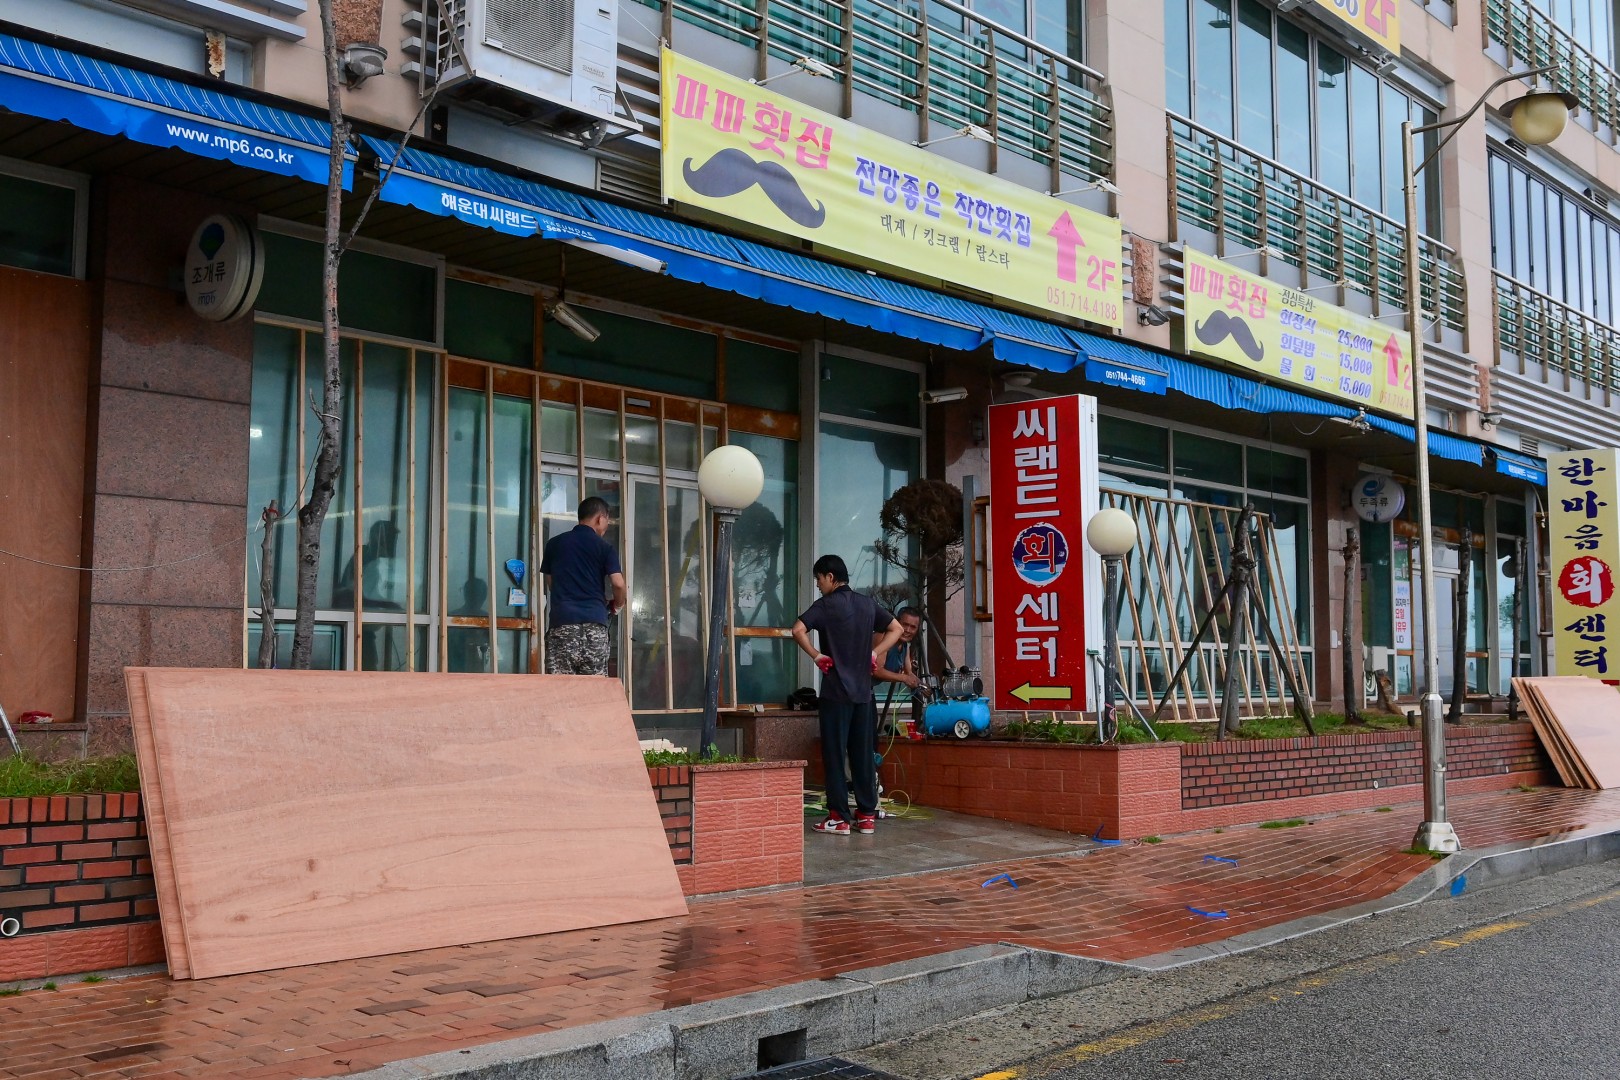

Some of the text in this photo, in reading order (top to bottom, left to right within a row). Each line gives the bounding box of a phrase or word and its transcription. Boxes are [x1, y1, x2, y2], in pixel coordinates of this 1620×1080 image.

[672, 73, 834, 170] 파파횟집
[166, 123, 295, 165] www.mp6.co.kr
[441, 192, 537, 229] 해운대씨랜드
[855, 156, 1032, 248] 전망좋은 착한횟집
[880, 214, 906, 238] 대게
[923, 228, 960, 255] 킹크랩
[975, 244, 1011, 270] 랍스타
[191, 261, 226, 284] 조개류
[1087, 255, 1116, 293] 2F
[1189, 262, 1269, 320] 파파횟집
[1047, 286, 1117, 321] 051.714.4188
[1280, 308, 1373, 353] 회정식 25,000
[1280, 333, 1373, 376] 회덮밥 15,000
[1339, 376, 1371, 399] 15,000
